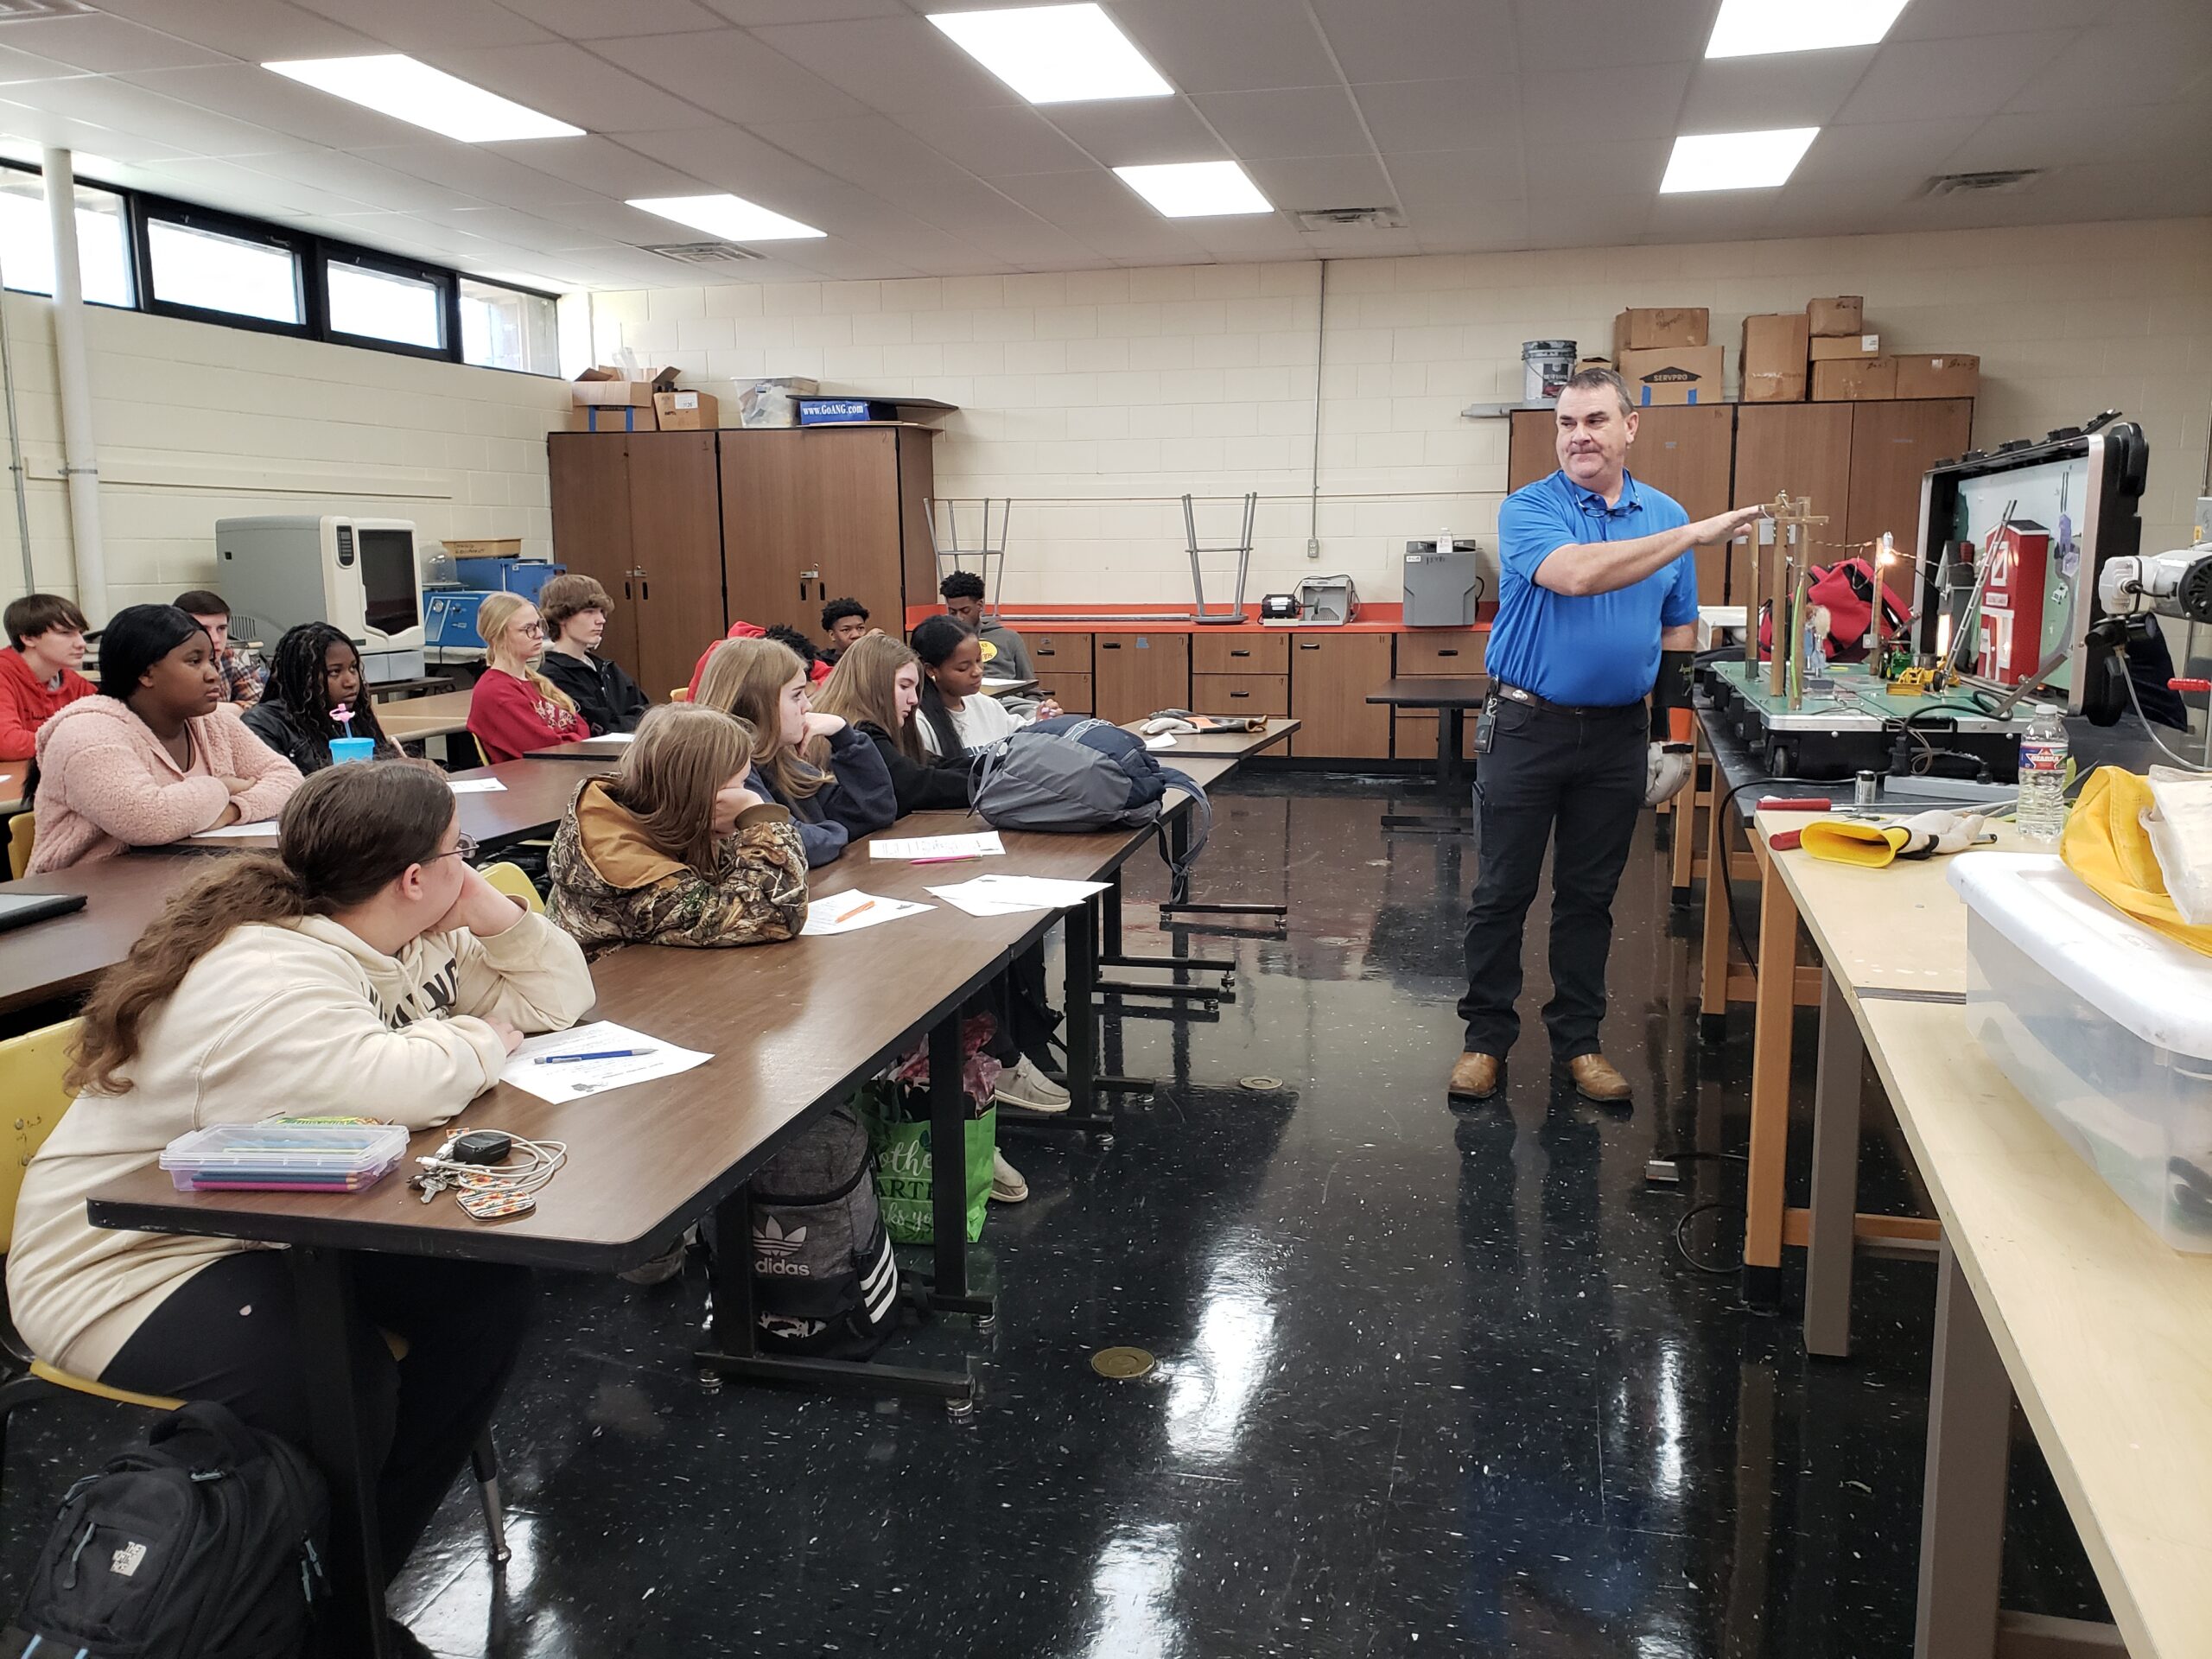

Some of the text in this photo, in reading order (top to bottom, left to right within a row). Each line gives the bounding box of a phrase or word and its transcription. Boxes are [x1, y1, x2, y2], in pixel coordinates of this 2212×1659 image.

[1653, 373, 1688, 382] SERVPRO
[802, 404, 863, 416] www.GoANG.com
[879, 1139, 932, 1177] othe
[754, 1257, 810, 1276] didas
